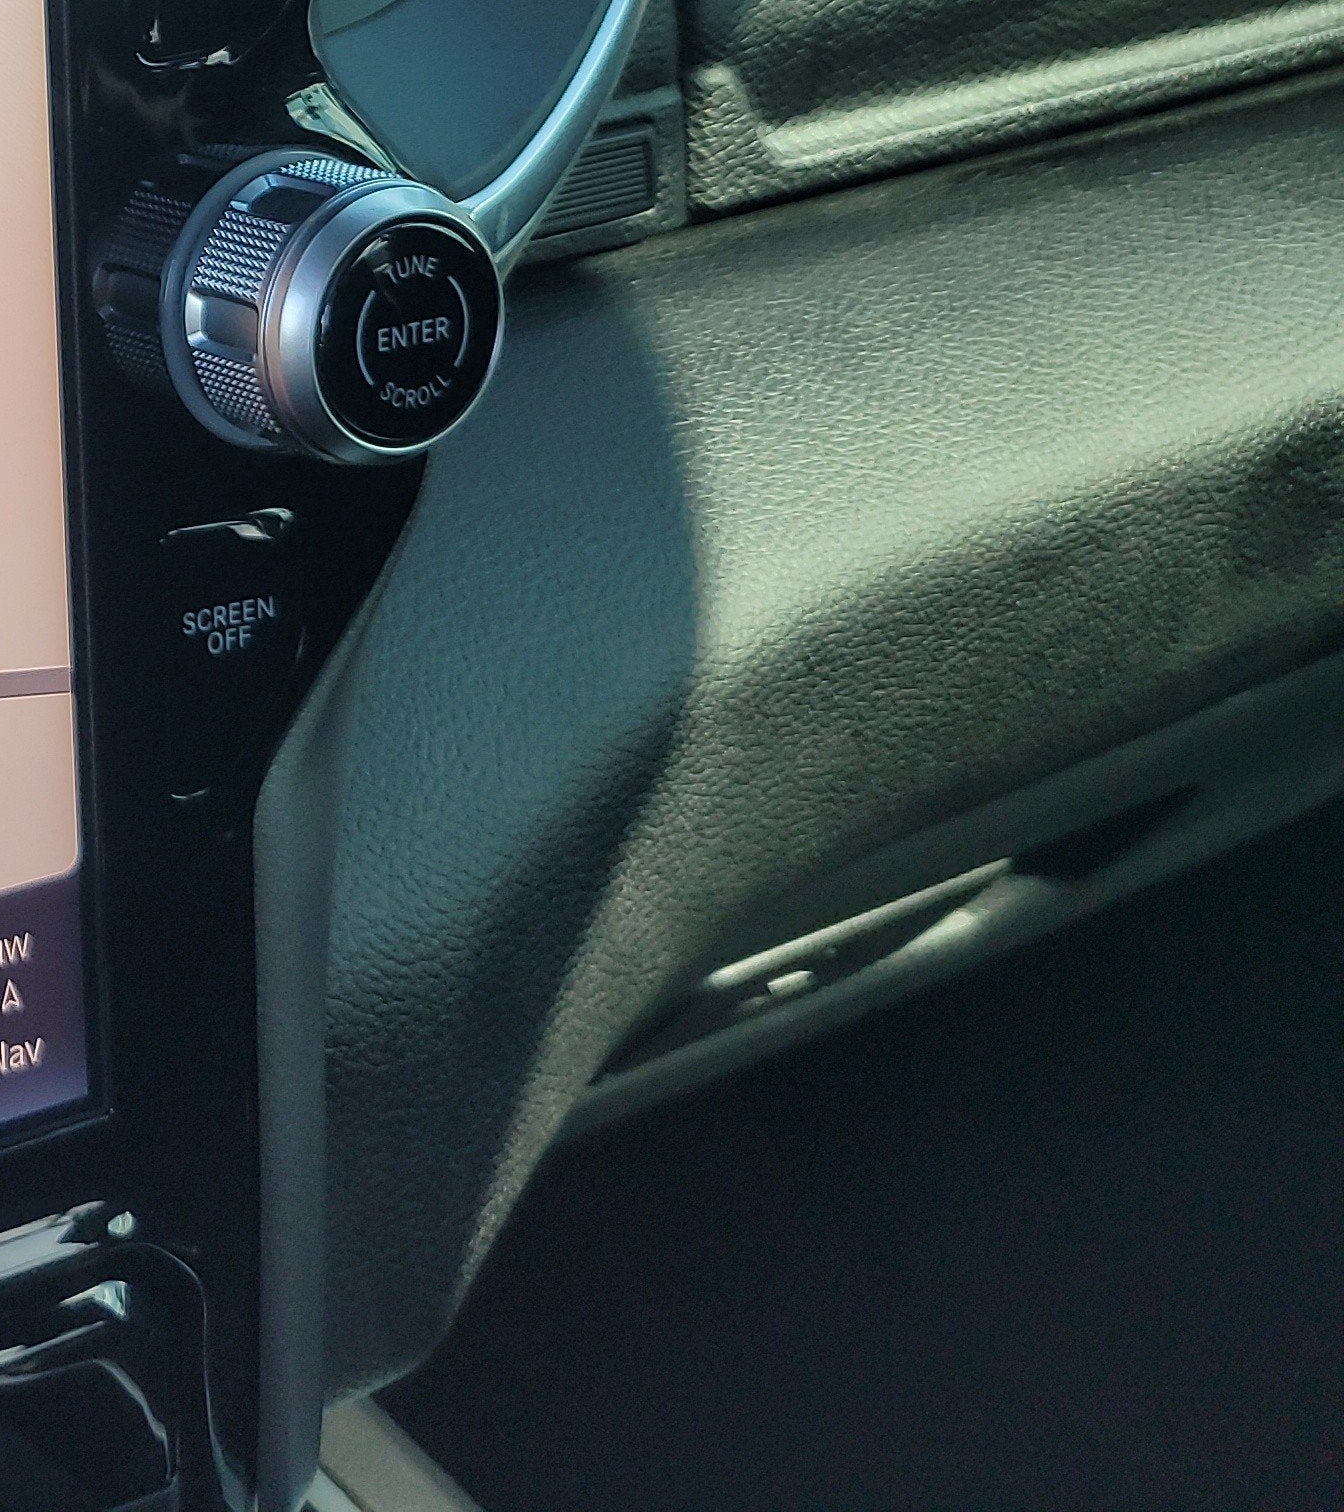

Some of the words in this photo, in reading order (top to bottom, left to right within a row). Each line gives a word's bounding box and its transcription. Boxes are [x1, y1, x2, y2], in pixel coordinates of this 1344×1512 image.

[376, 254, 440, 285] TUNE
[377, 317, 450, 353] ENTER
[380, 374, 452, 410] SCROLL
[182, 595, 276, 637] SCREEN
[207, 624, 253, 656] OFF
